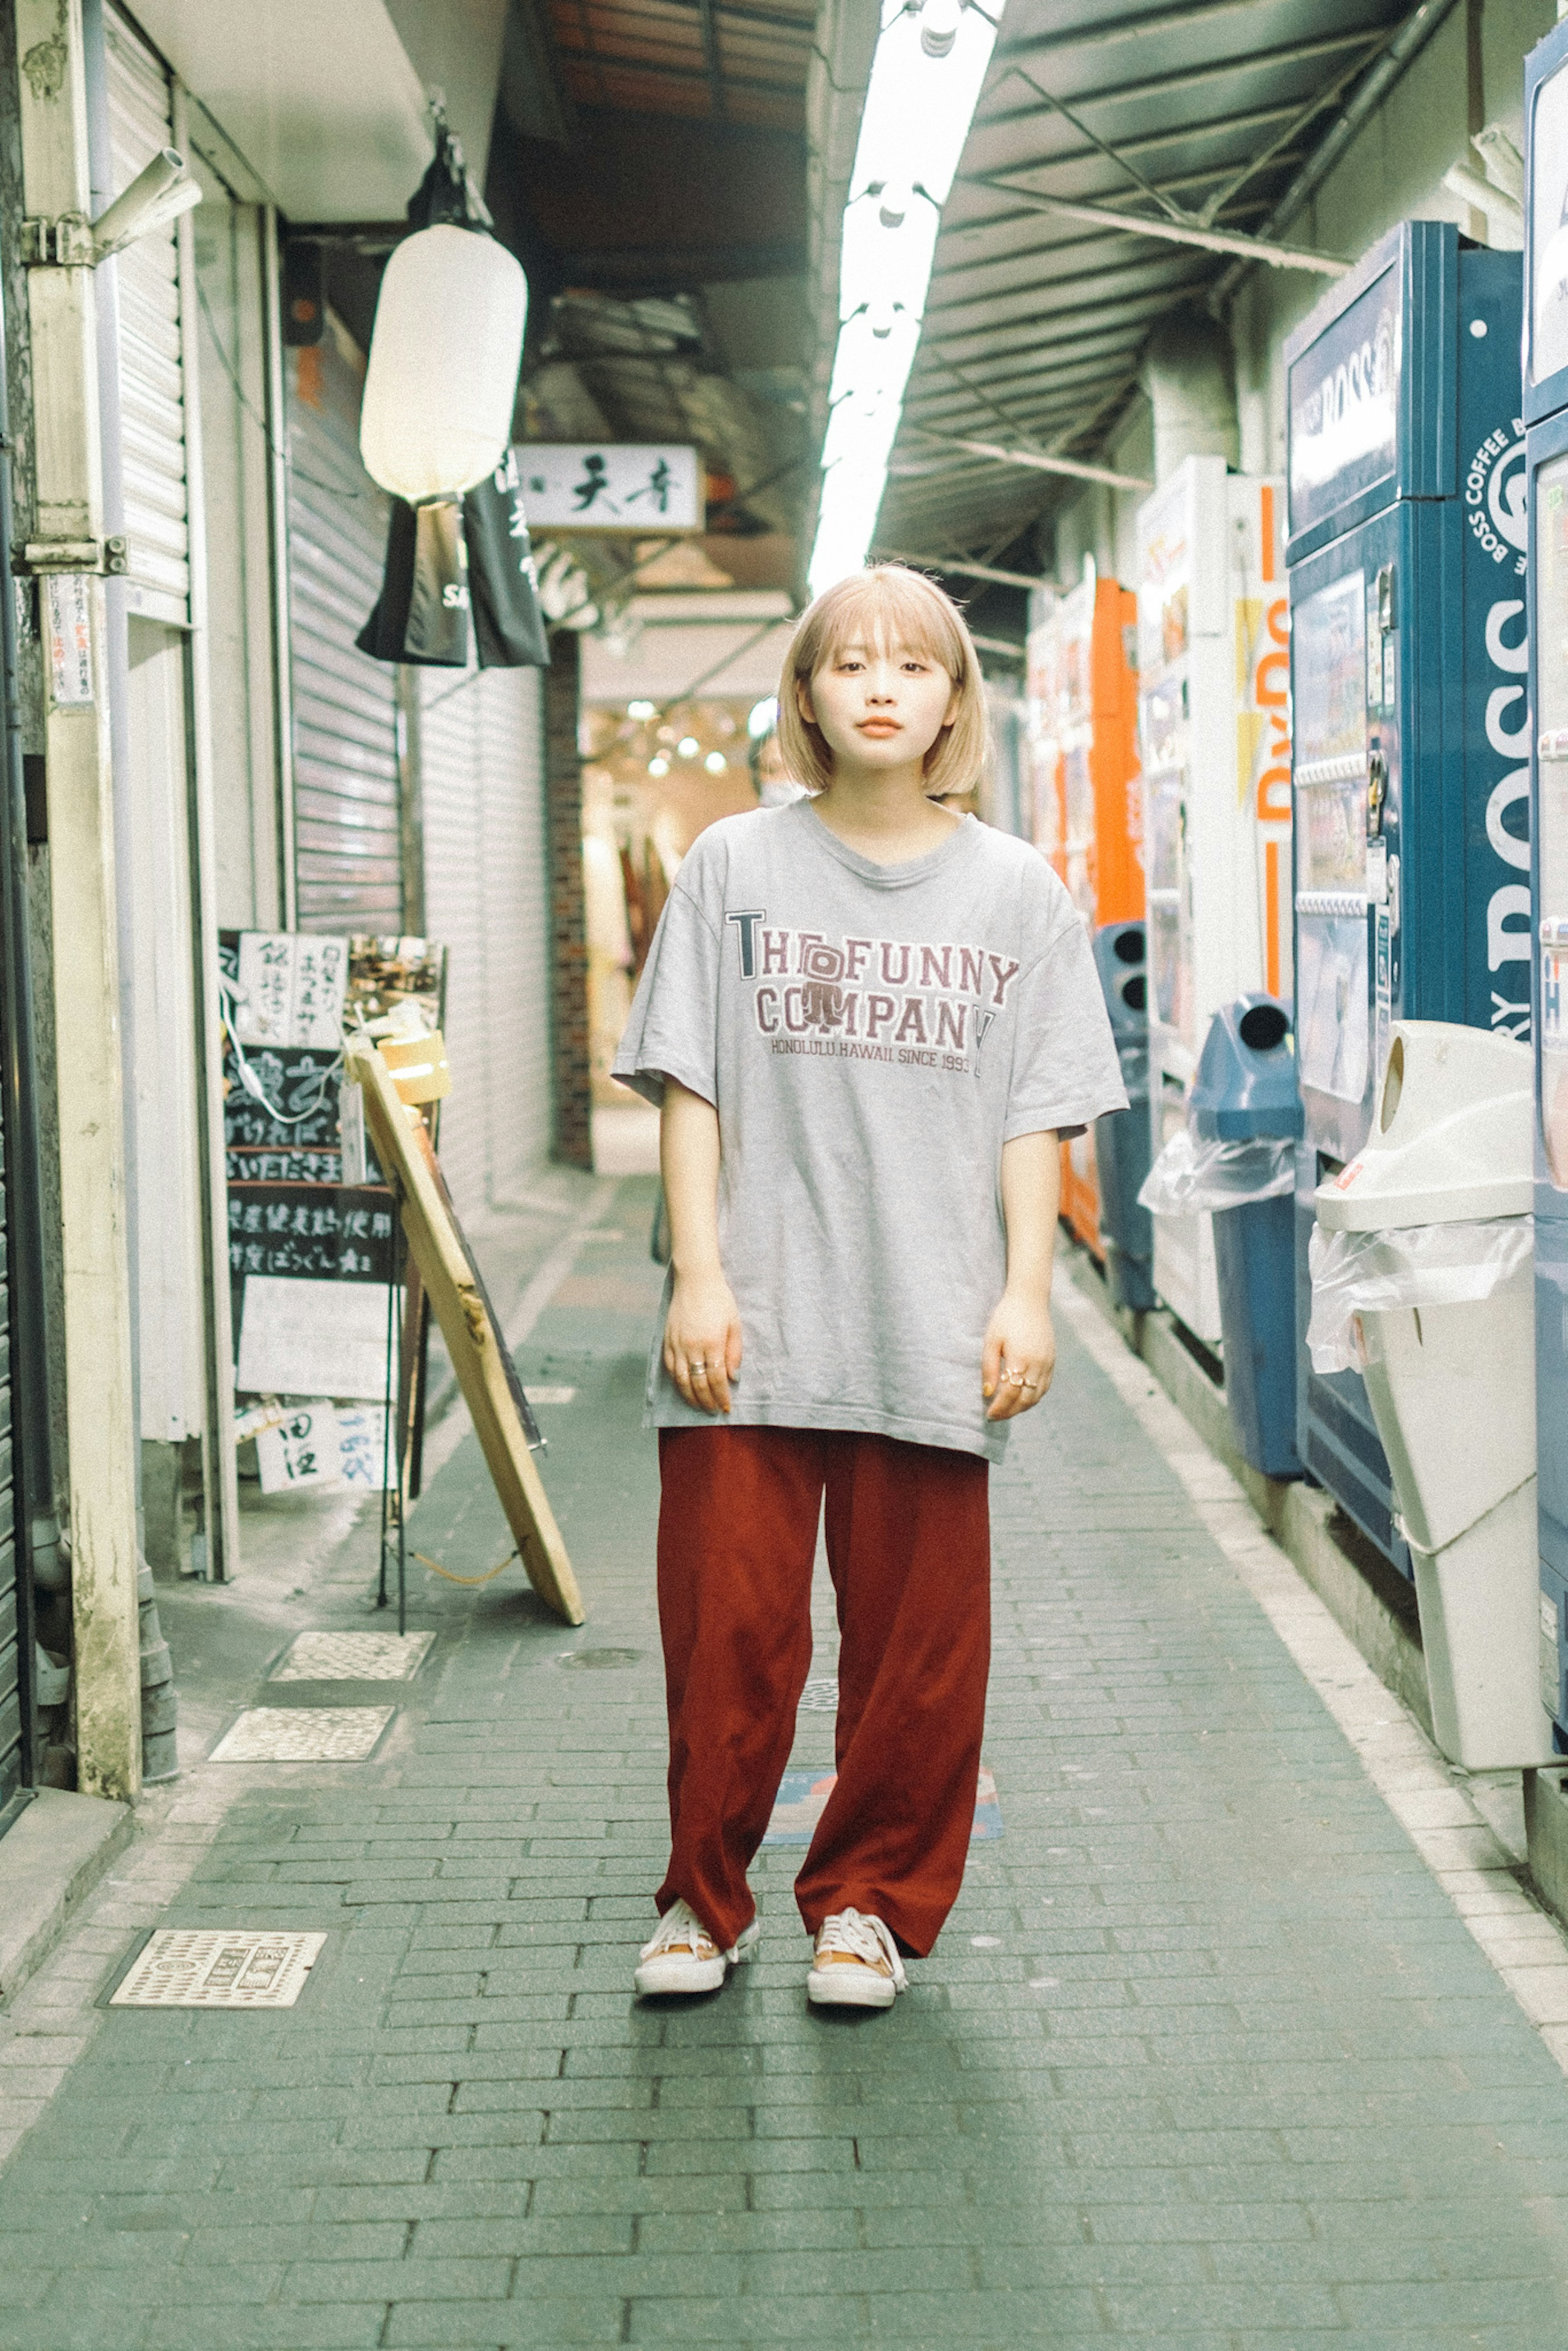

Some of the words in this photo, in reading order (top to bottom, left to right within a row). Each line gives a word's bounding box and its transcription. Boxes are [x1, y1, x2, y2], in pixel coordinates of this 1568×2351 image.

[1466, 428, 1509, 505] COFFEE
[1468, 510, 1509, 564] BOSS
[842, 935, 1020, 1009] FUNNY
[754, 983, 996, 1078] COMPANY
[898, 1049, 937, 1067] SINCE
